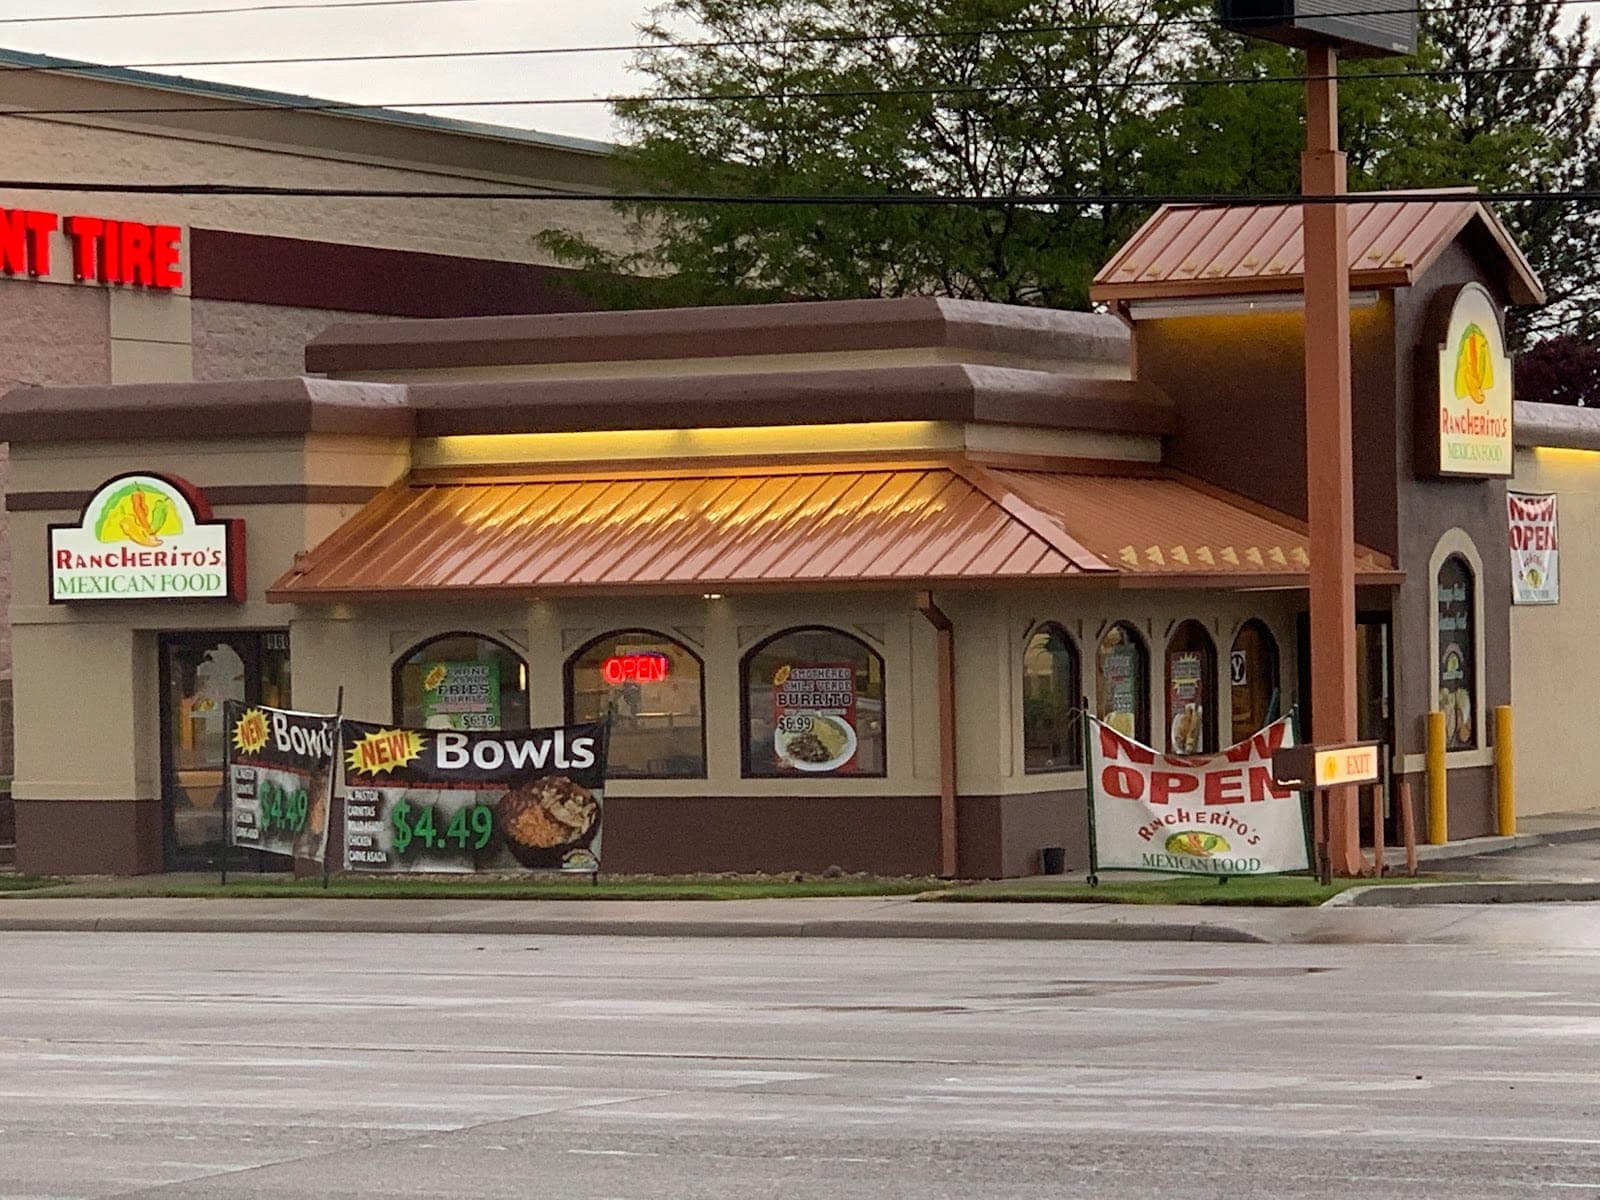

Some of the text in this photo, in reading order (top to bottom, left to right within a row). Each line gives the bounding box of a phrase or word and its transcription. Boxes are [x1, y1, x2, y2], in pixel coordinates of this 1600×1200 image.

[65, 215, 183, 289] TIRE
[1510, 525, 1557, 550] OPEN
[57, 573, 221, 594] MEXICAN FOOD
[604, 657, 666, 682] OPEN
[437, 684, 490, 695] FRIES
[777, 693, 852, 706] BURRITO
[462, 714, 496, 729] $6.79
[778, 716, 812, 730] $6.99
[360, 731, 412, 769] NEW!
[436, 730, 595, 770] Bowls
[1100, 723, 1285, 767] NW
[1346, 753, 1371, 775] EXIT
[355, 790, 379, 801] PASTOR
[1102, 764, 1291, 805] OPEN
[391, 797, 493, 853] $4.49
[1142, 853, 1261, 872] MEXICAN FOOD
